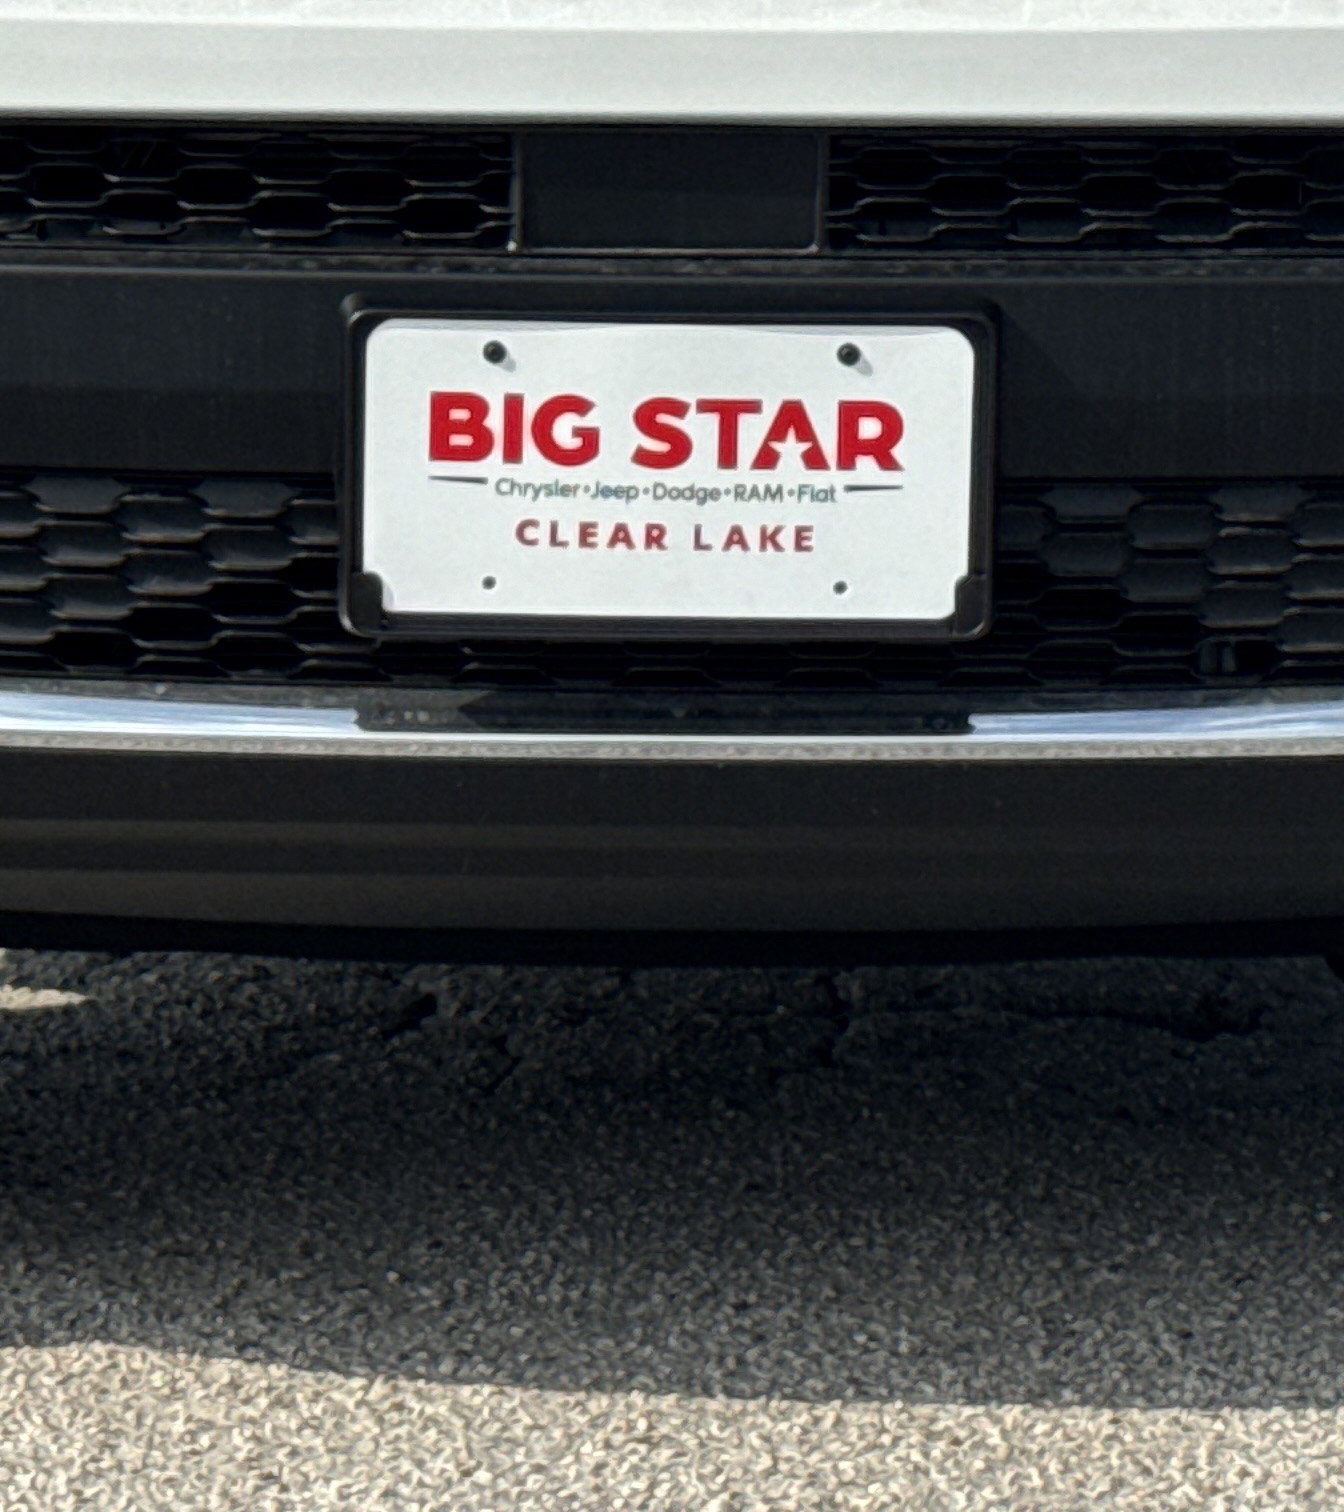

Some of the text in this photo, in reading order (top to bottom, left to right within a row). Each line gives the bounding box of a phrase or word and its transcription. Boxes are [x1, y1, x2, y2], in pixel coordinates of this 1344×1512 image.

[428, 391, 905, 472] BIG STAR
[515, 518, 815, 553] CLEAR LAKE
